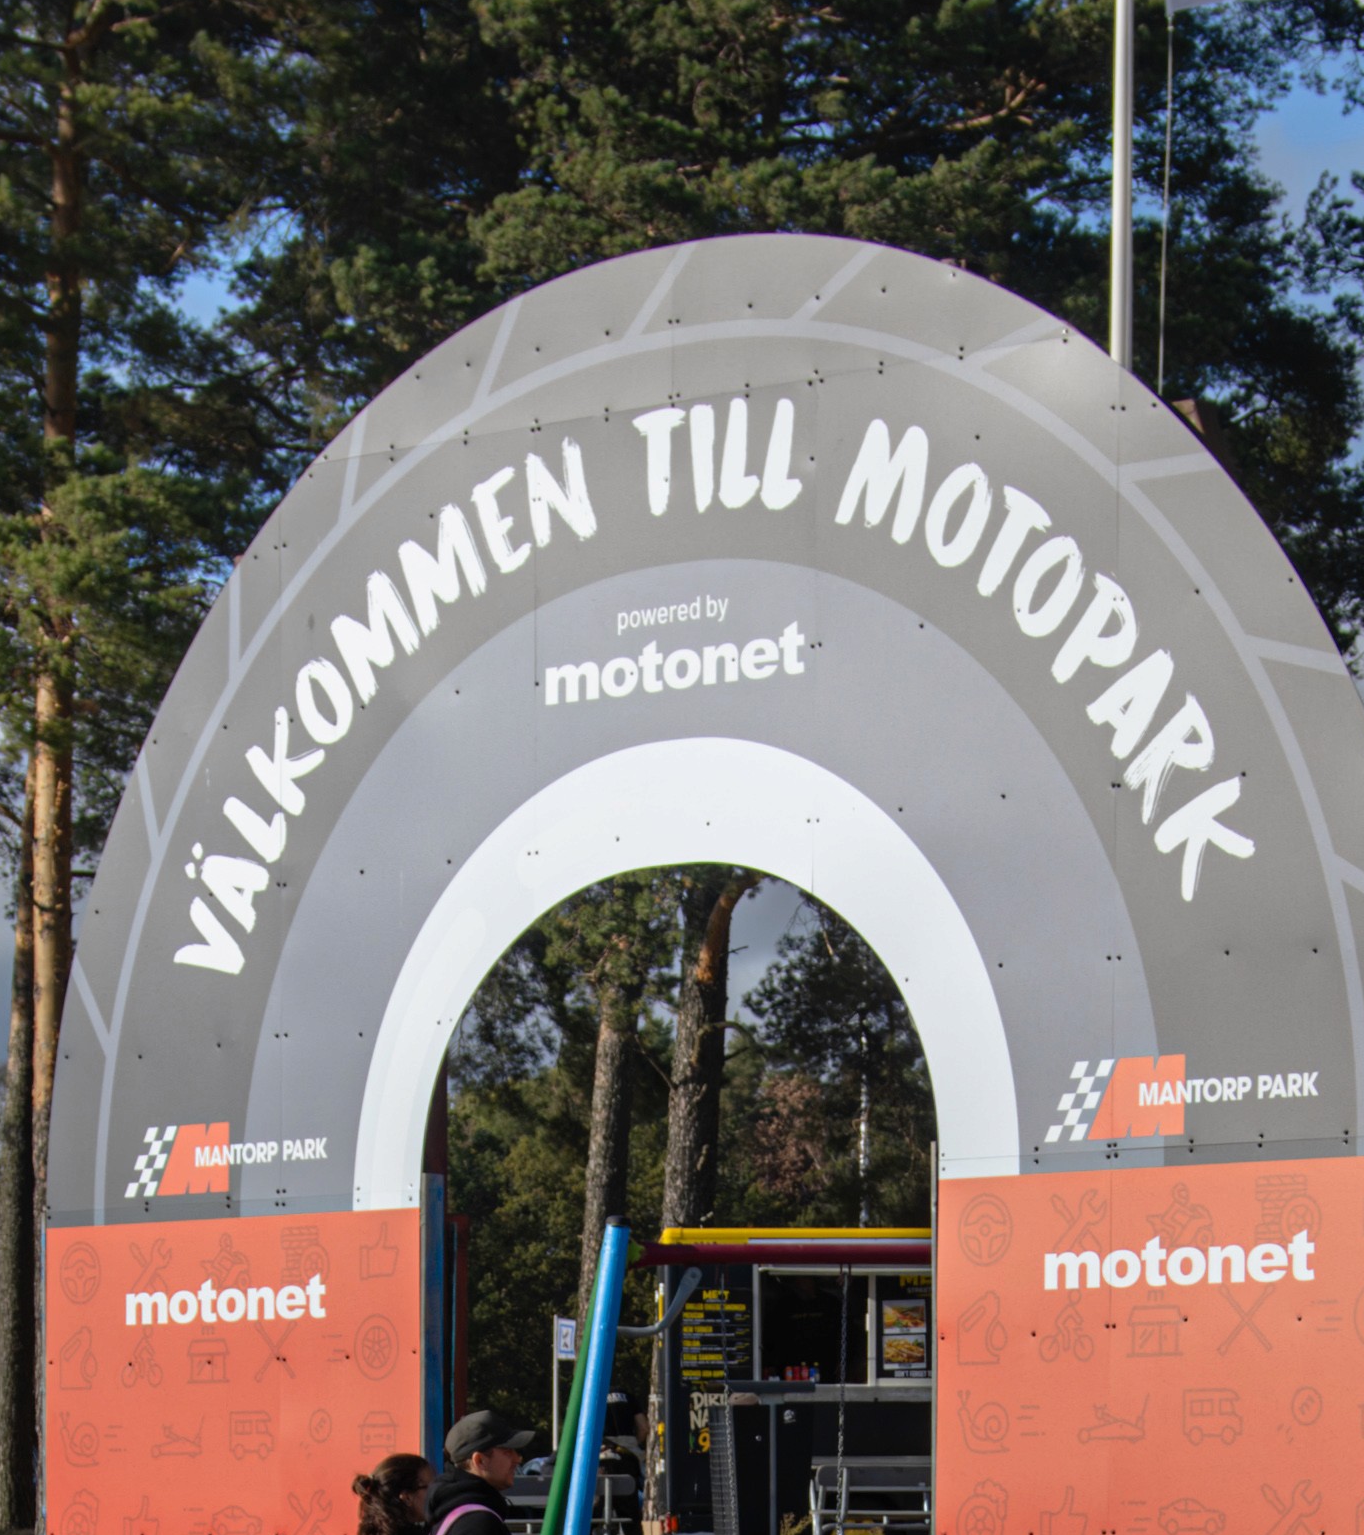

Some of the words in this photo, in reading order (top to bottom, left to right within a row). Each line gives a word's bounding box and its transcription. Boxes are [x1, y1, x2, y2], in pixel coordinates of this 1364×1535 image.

[617, 596, 701, 636] powered
[706, 595, 729, 622] by
[545, 620, 805, 705] motonet
[174, 438, 597, 975] VÄLKOMMEN
[633, 398, 802, 517] TILL
[835, 418, 1256, 902] MOTOPARK
[1139, 1076, 1252, 1107] MANTORP
[1257, 1071, 1320, 1100] PARK
[194, 1141, 279, 1168] MANTORP
[282, 1137, 328, 1161] PARK
[1045, 1229, 1316, 1290] motonet
[125, 1273, 326, 1326] motonet
[690, 1391, 727, 1411] DIRT
